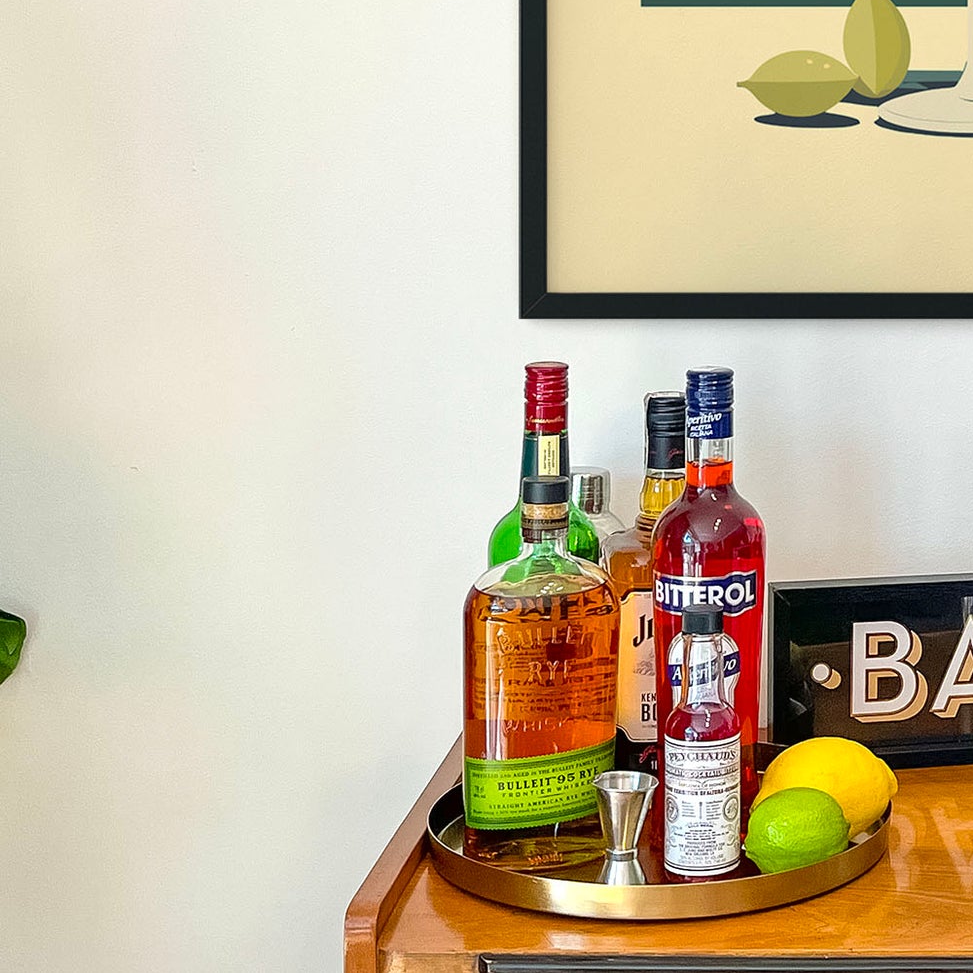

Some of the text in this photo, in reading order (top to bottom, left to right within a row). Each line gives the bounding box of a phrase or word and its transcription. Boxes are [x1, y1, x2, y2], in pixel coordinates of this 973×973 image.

[687, 412, 722, 427] peritivo
[655, 579, 754, 607] BITTEROL
[557, 772, 575, 785] 95
[580, 766, 599, 779] RYE
[502, 787, 552, 798] FRONTIER
